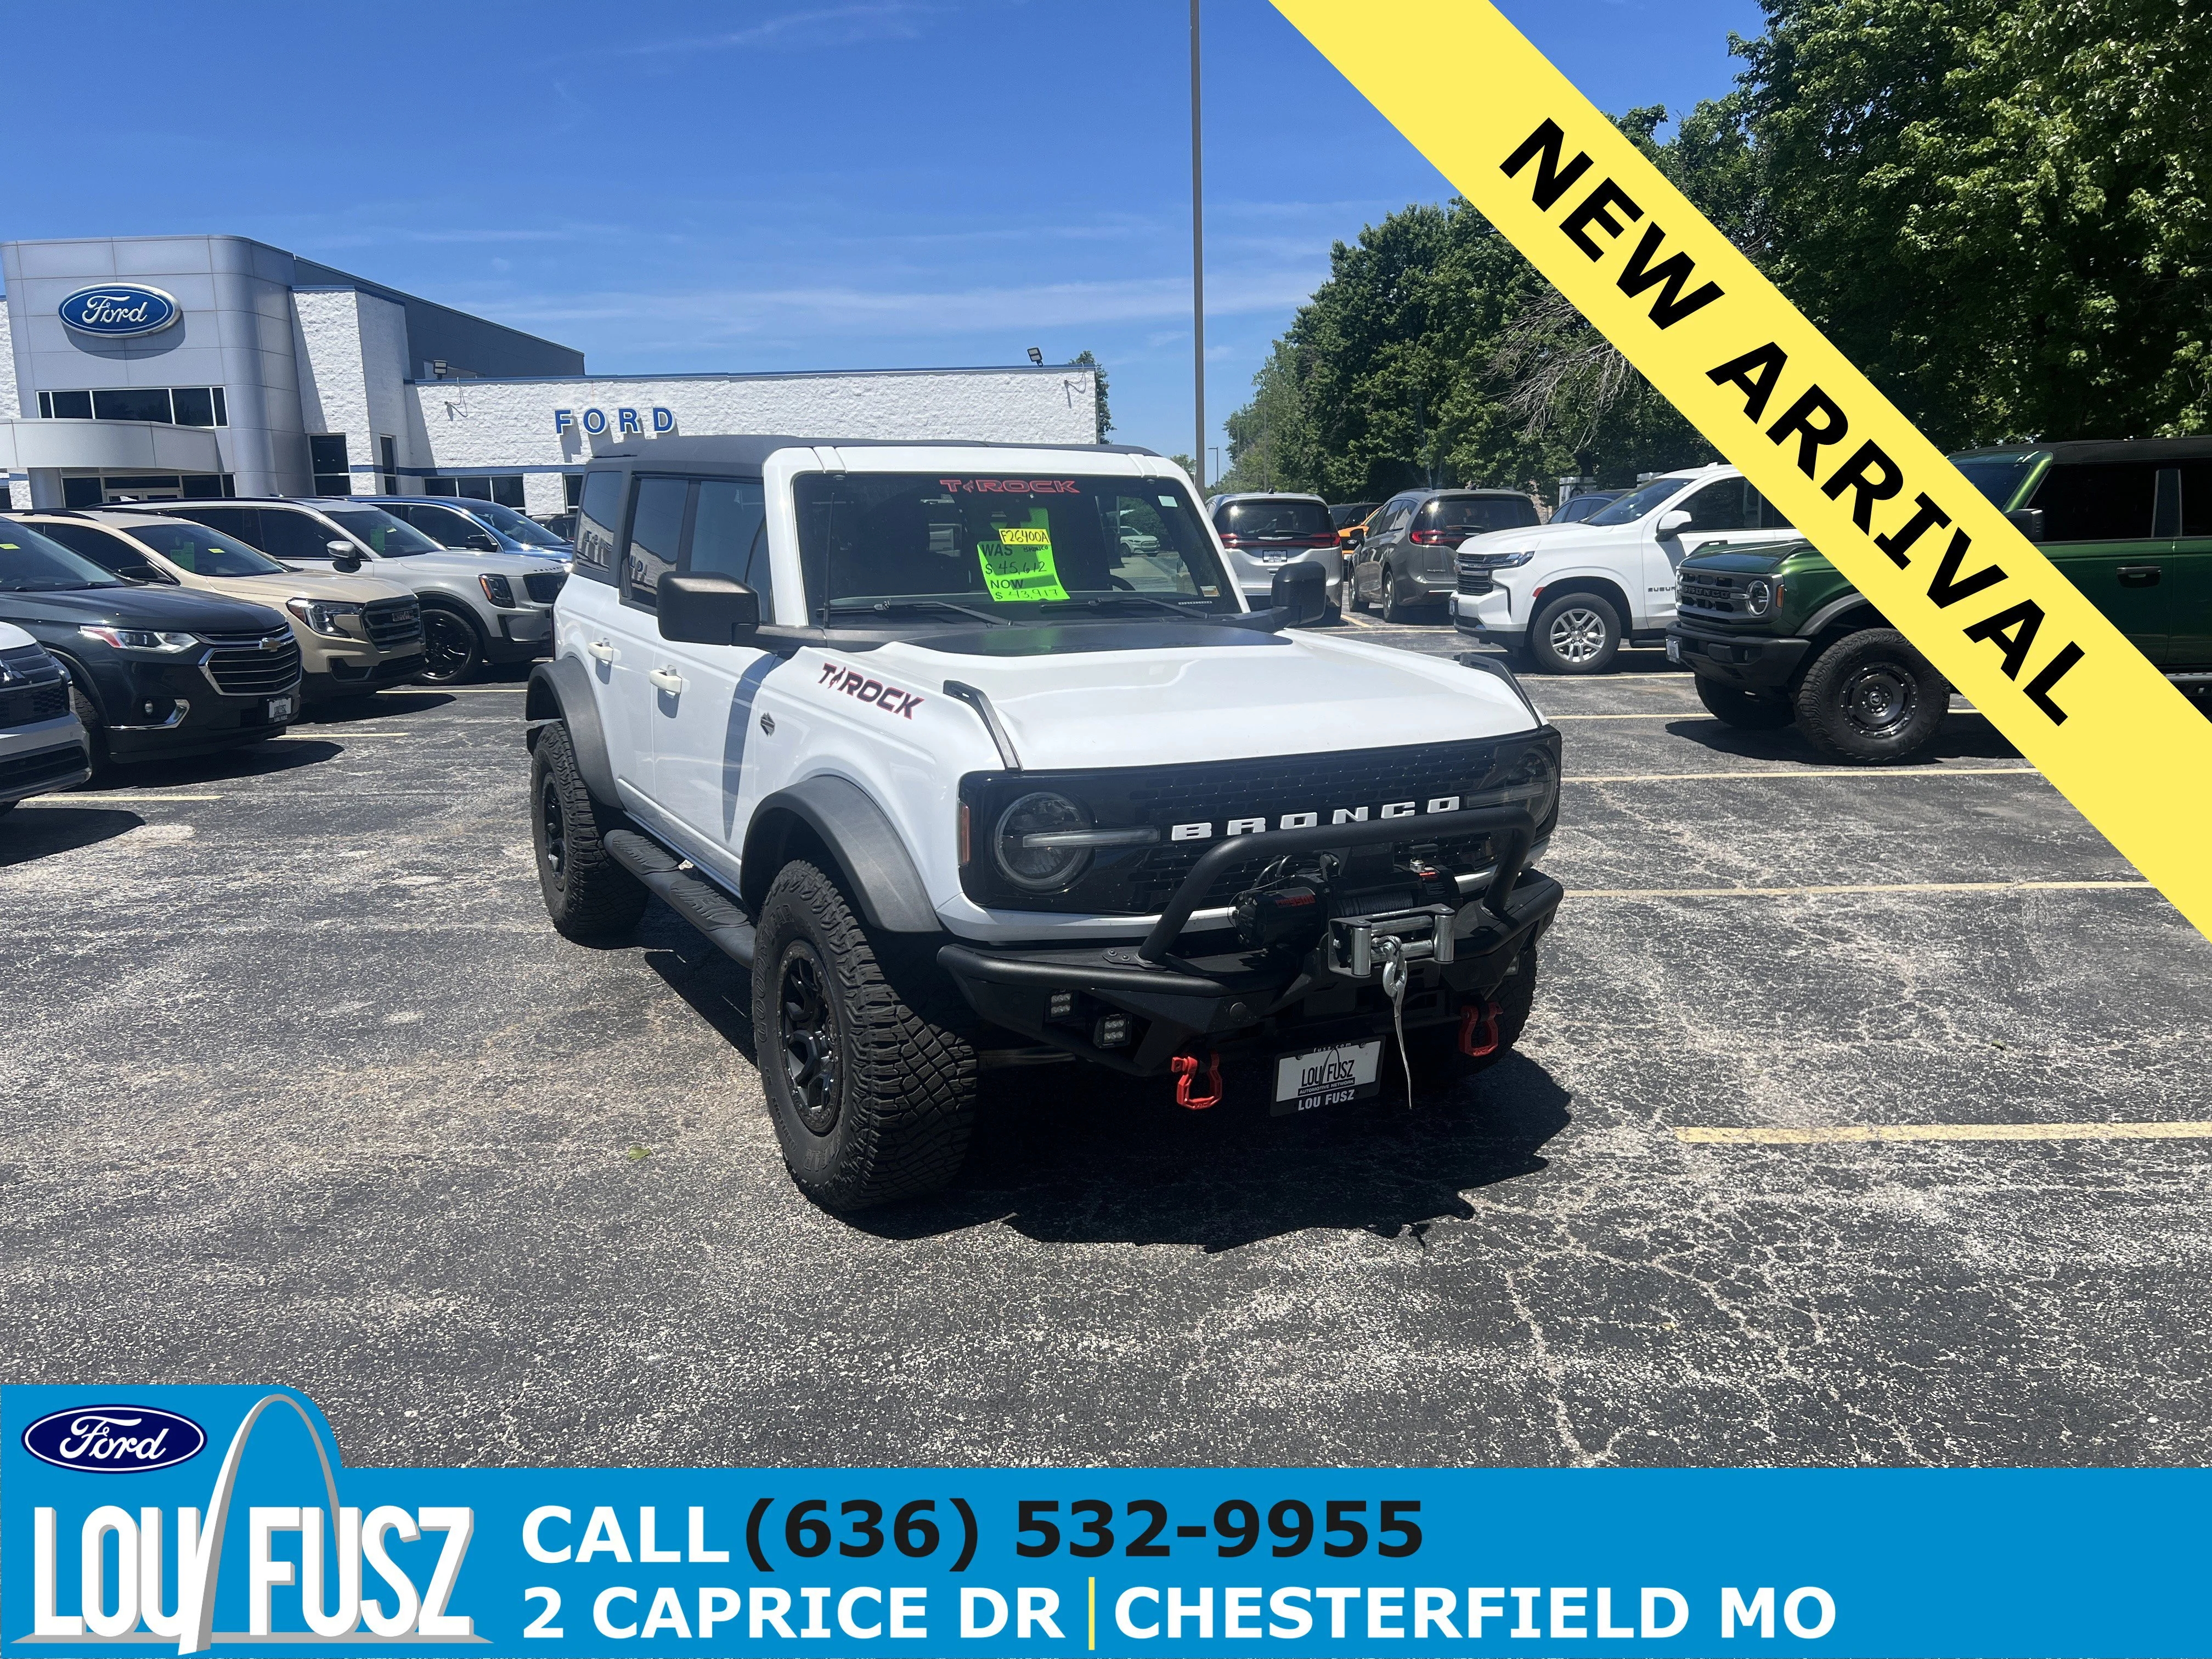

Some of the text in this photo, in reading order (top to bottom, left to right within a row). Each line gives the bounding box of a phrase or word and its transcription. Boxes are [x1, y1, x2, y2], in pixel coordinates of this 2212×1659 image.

[82, 295, 148, 324] Ford
[554, 407, 676, 436] FORD
[1000, 530, 1049, 543] F26400A
[981, 544, 1013, 556] WAS
[998, 561, 1047, 575] 45,612
[990, 579, 1023, 589] NOW
[1008, 589, 1058, 600] 43,917
[1171, 796, 1460, 841] BRONCO
[1301, 1059, 1355, 1087] LOU FUSZ
[1299, 1079, 1354, 1094] AUTOMOTIVE NETWORK
[1298, 1089, 1355, 1111] LOU FUSZ
